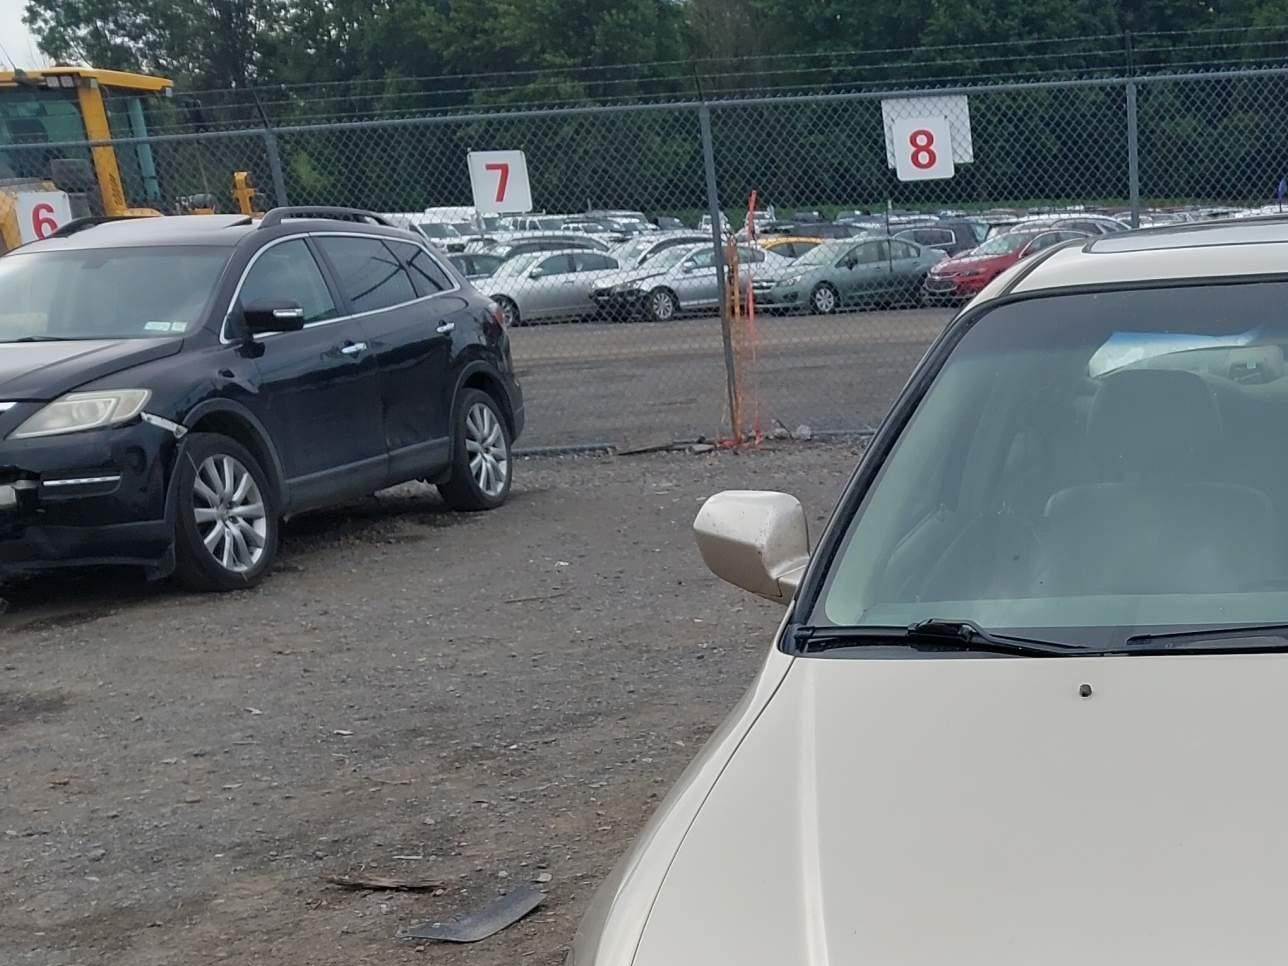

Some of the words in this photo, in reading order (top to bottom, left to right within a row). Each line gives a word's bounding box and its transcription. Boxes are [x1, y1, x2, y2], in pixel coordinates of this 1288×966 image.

[908, 129, 937, 170] 8
[484, 163, 510, 203] 7
[32, 203, 59, 241] 6
